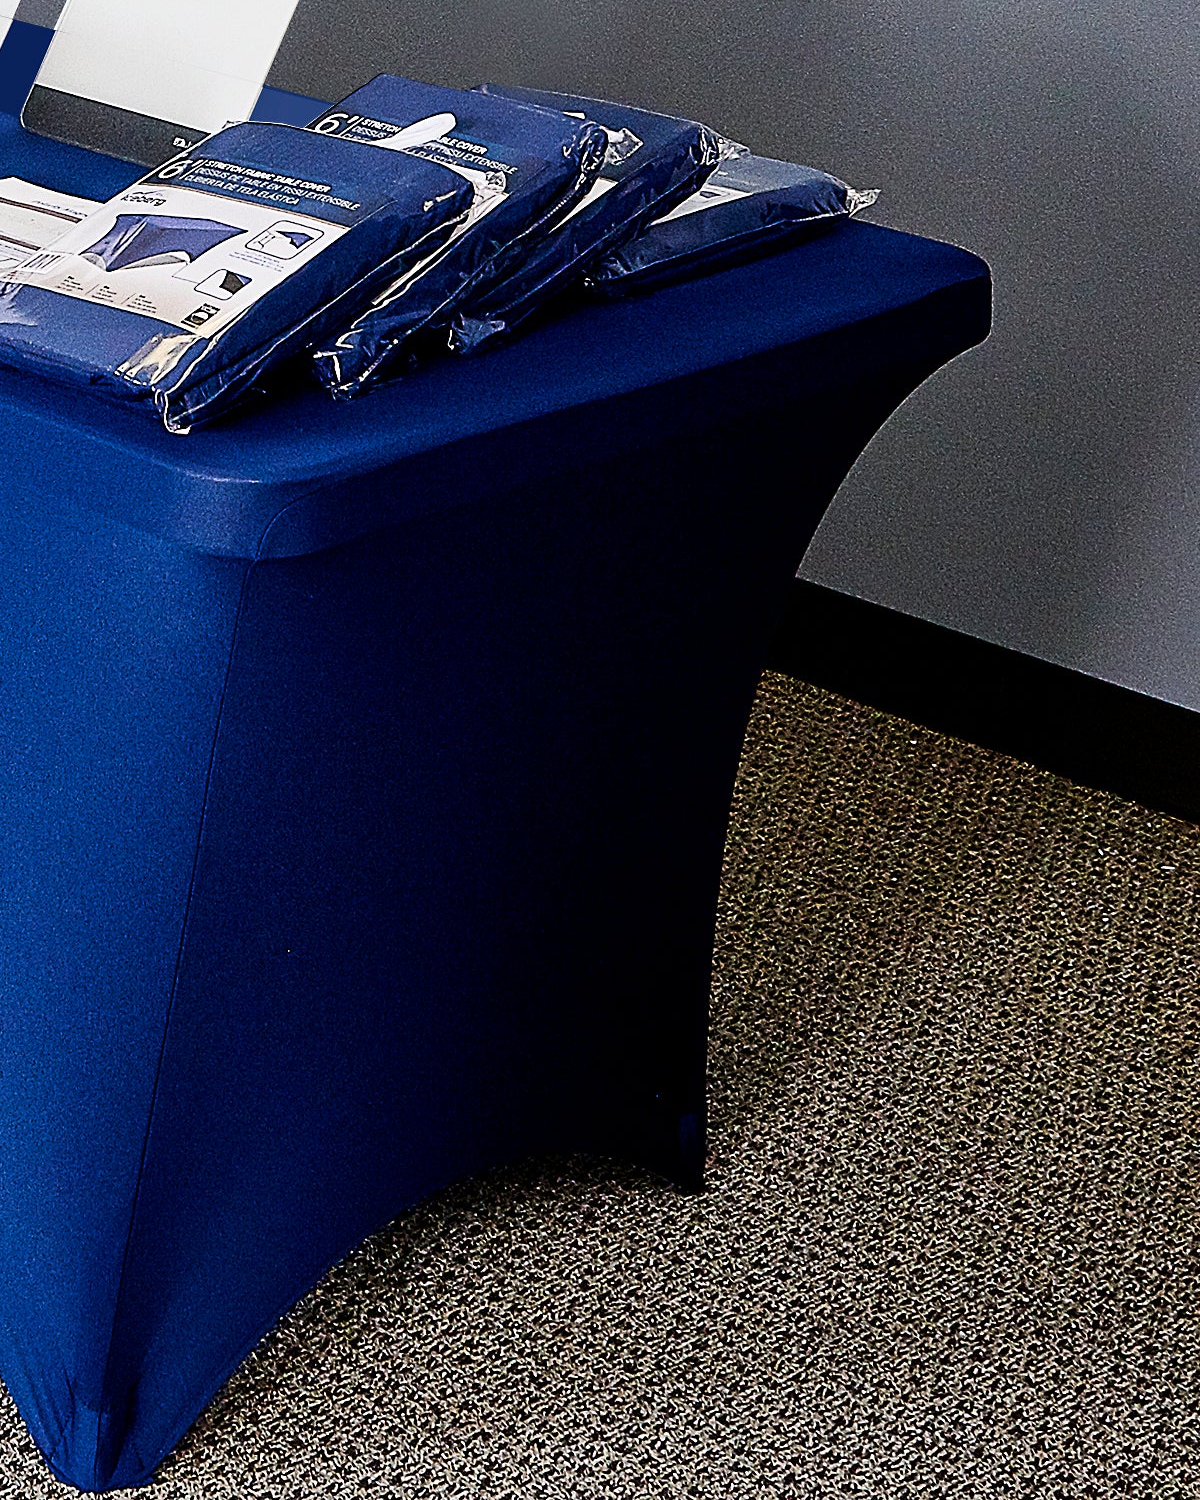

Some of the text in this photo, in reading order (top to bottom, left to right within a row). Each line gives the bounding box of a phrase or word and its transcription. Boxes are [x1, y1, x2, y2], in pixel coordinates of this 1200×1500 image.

[456, 141, 488, 155] COVER
[462, 153, 519, 175] EXTENSIBLE
[205, 159, 244, 174] STRETCH
[300, 180, 332, 194] COVER
[305, 190, 361, 211] EXTENSIBLE
